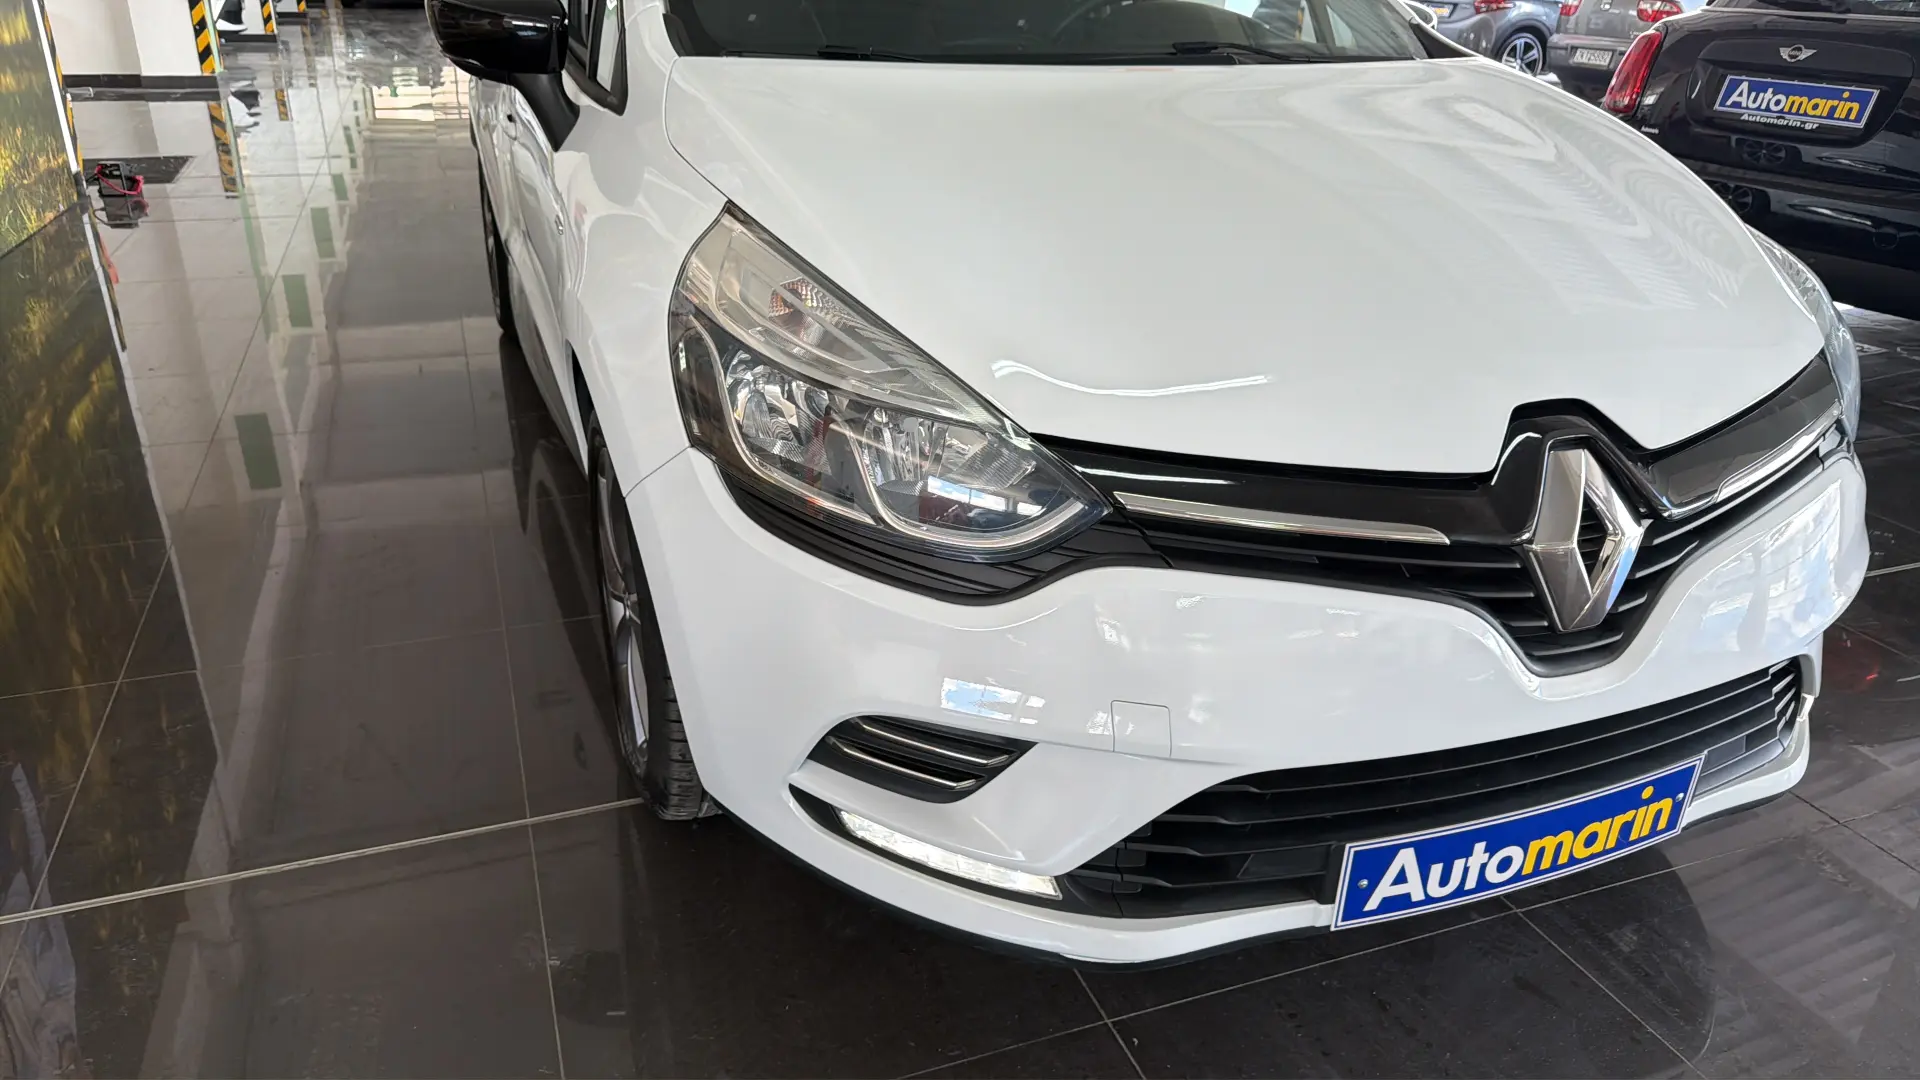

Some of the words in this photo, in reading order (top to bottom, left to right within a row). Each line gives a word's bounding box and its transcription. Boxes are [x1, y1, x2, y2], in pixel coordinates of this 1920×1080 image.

[1725, 81, 1860, 120] Automarin
[1740, 113, 1820, 130] Automarin.gr
[1363, 786, 1674, 911] Automarin
